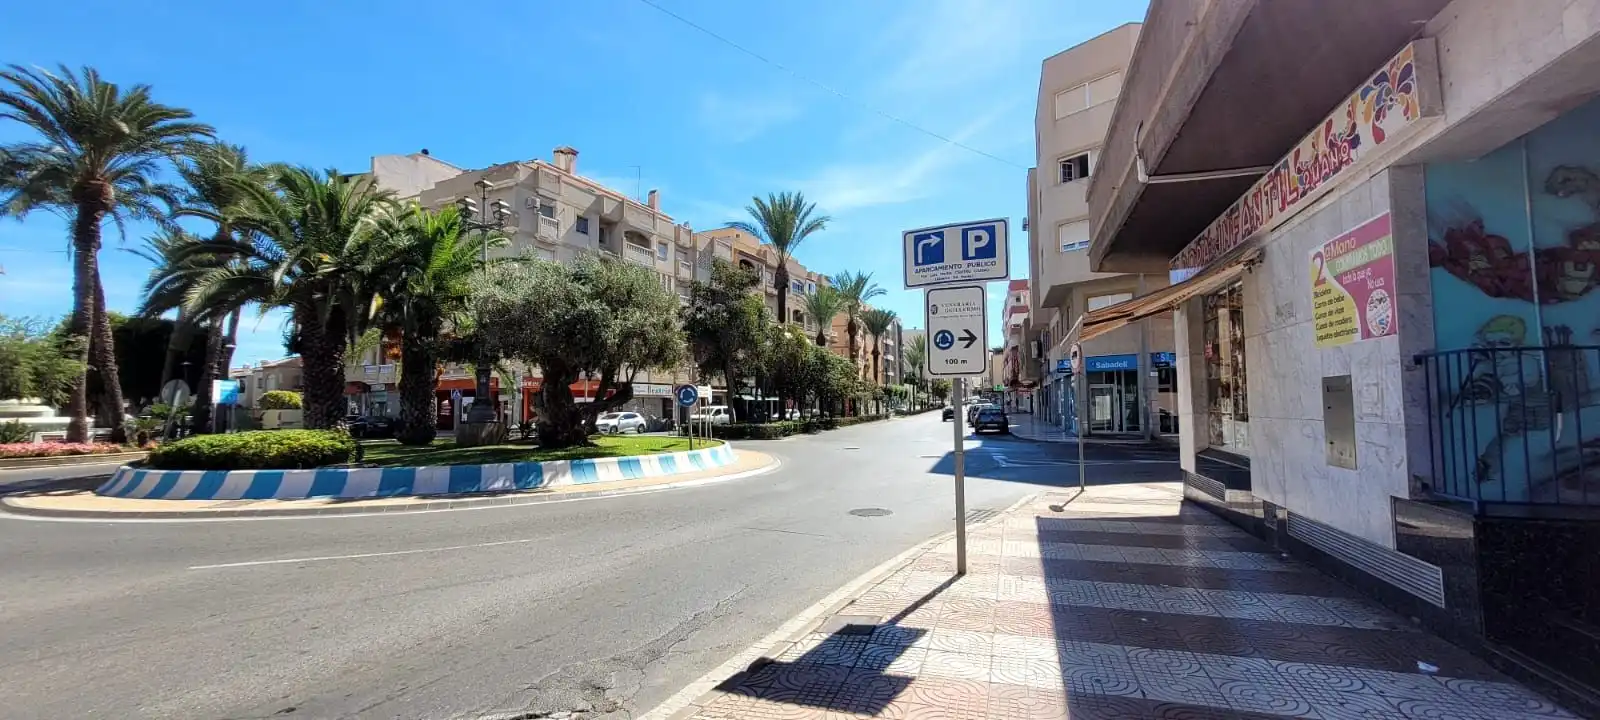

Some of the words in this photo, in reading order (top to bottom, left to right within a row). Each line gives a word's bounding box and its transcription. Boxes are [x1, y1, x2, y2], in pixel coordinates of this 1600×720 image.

[1216, 168, 1299, 255] INFANTIL
[968, 229, 990, 257] P
[914, 263, 963, 274] APARCAMIENTO
[1095, 360, 1128, 369] Sabadell
